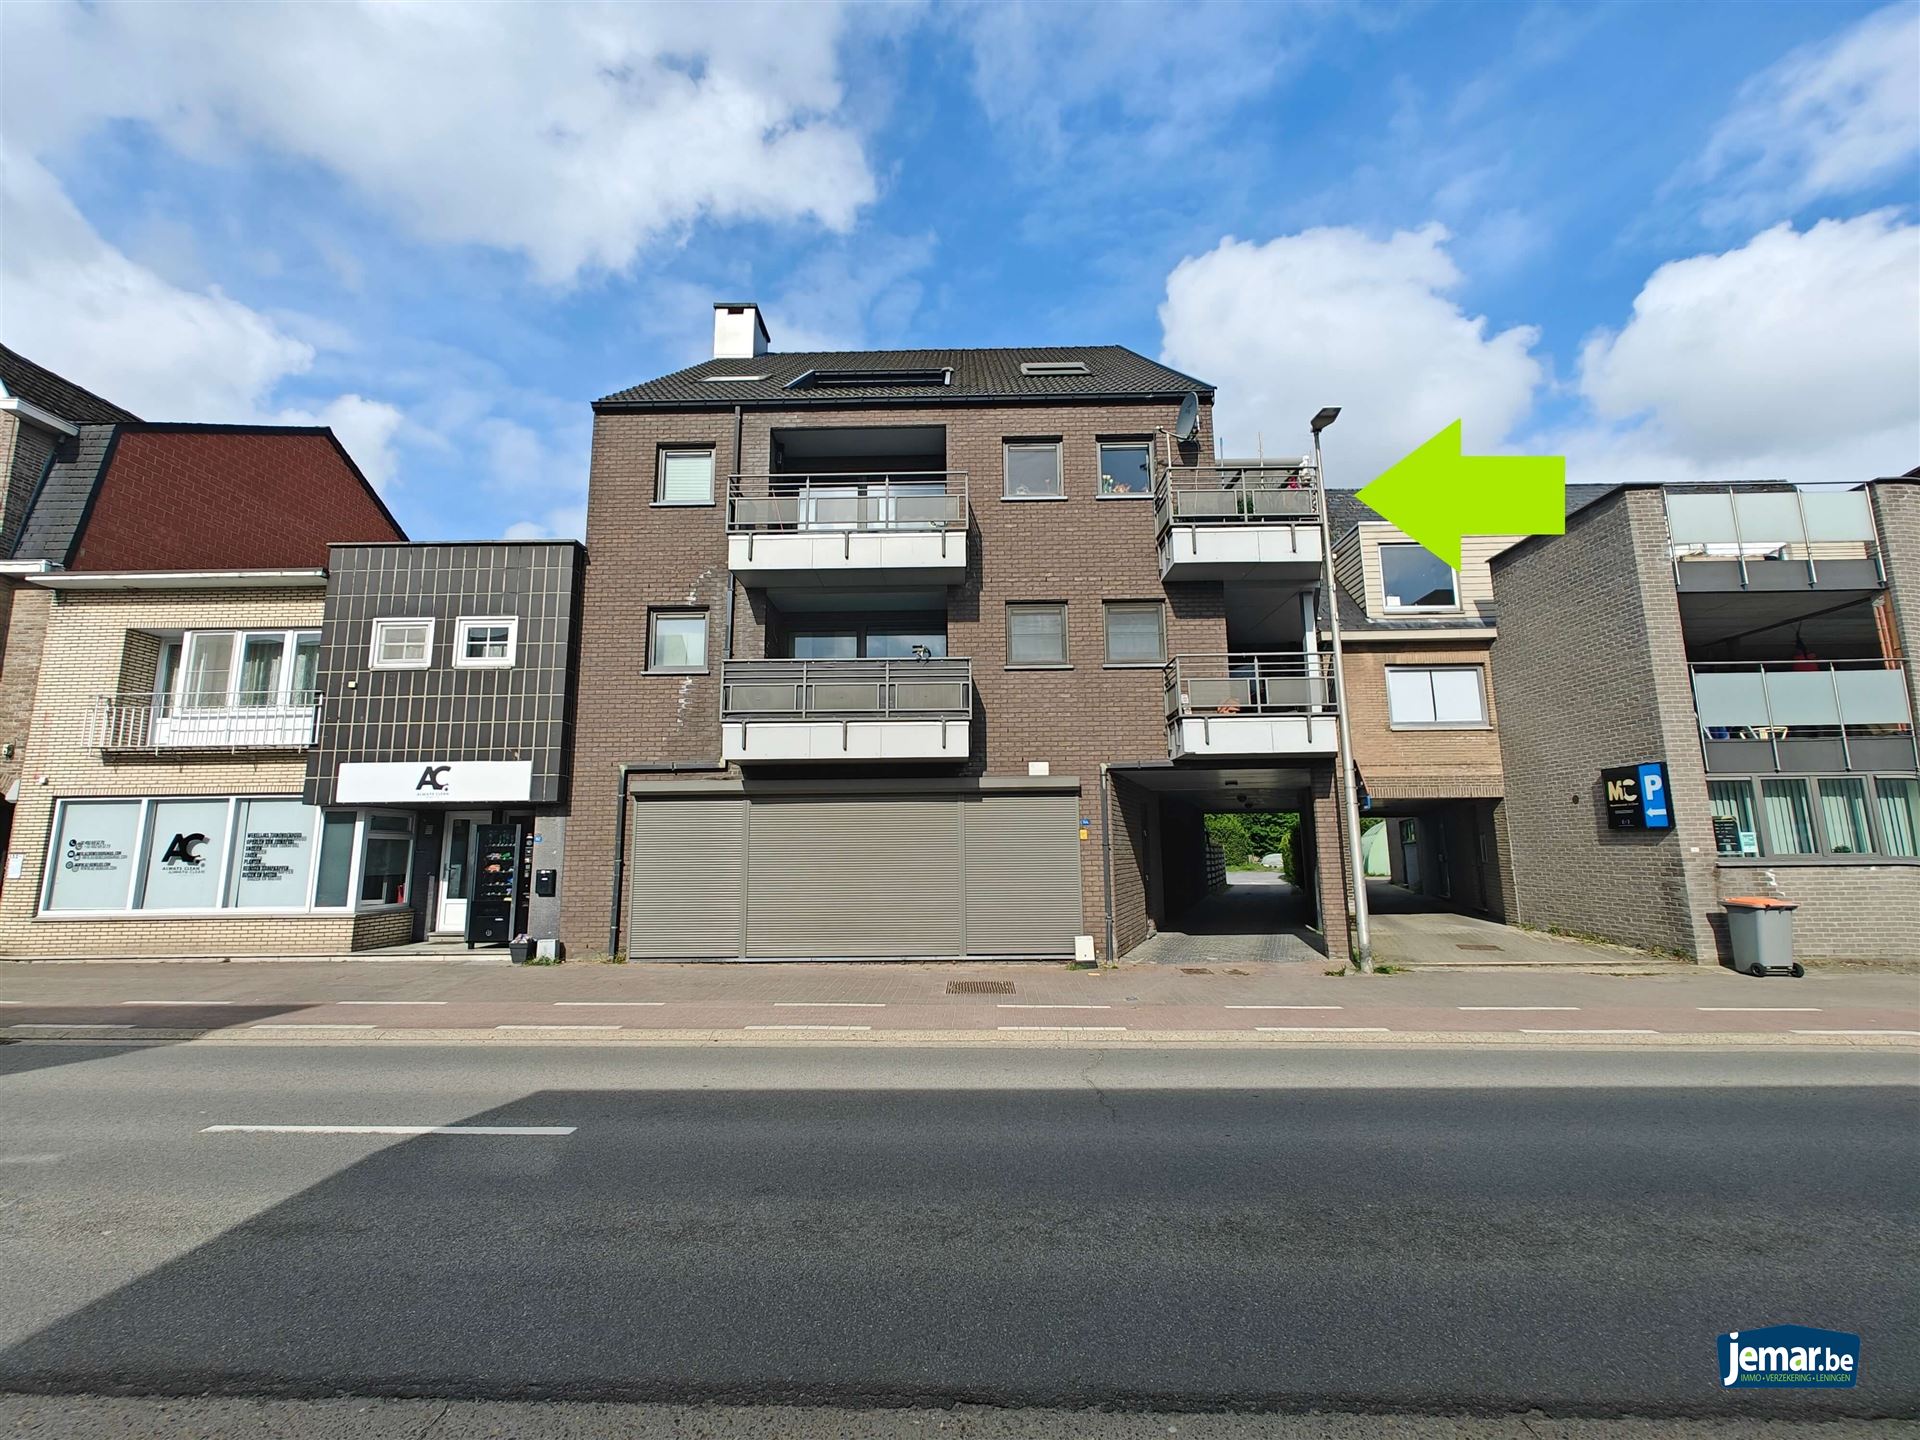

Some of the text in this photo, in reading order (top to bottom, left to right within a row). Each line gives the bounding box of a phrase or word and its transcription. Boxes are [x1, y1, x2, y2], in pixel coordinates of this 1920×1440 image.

[416, 766, 451, 791] AC
[1607, 778, 1638, 802] MC
[1644, 775, 1662, 801] P
[161, 833, 206, 863] AC
